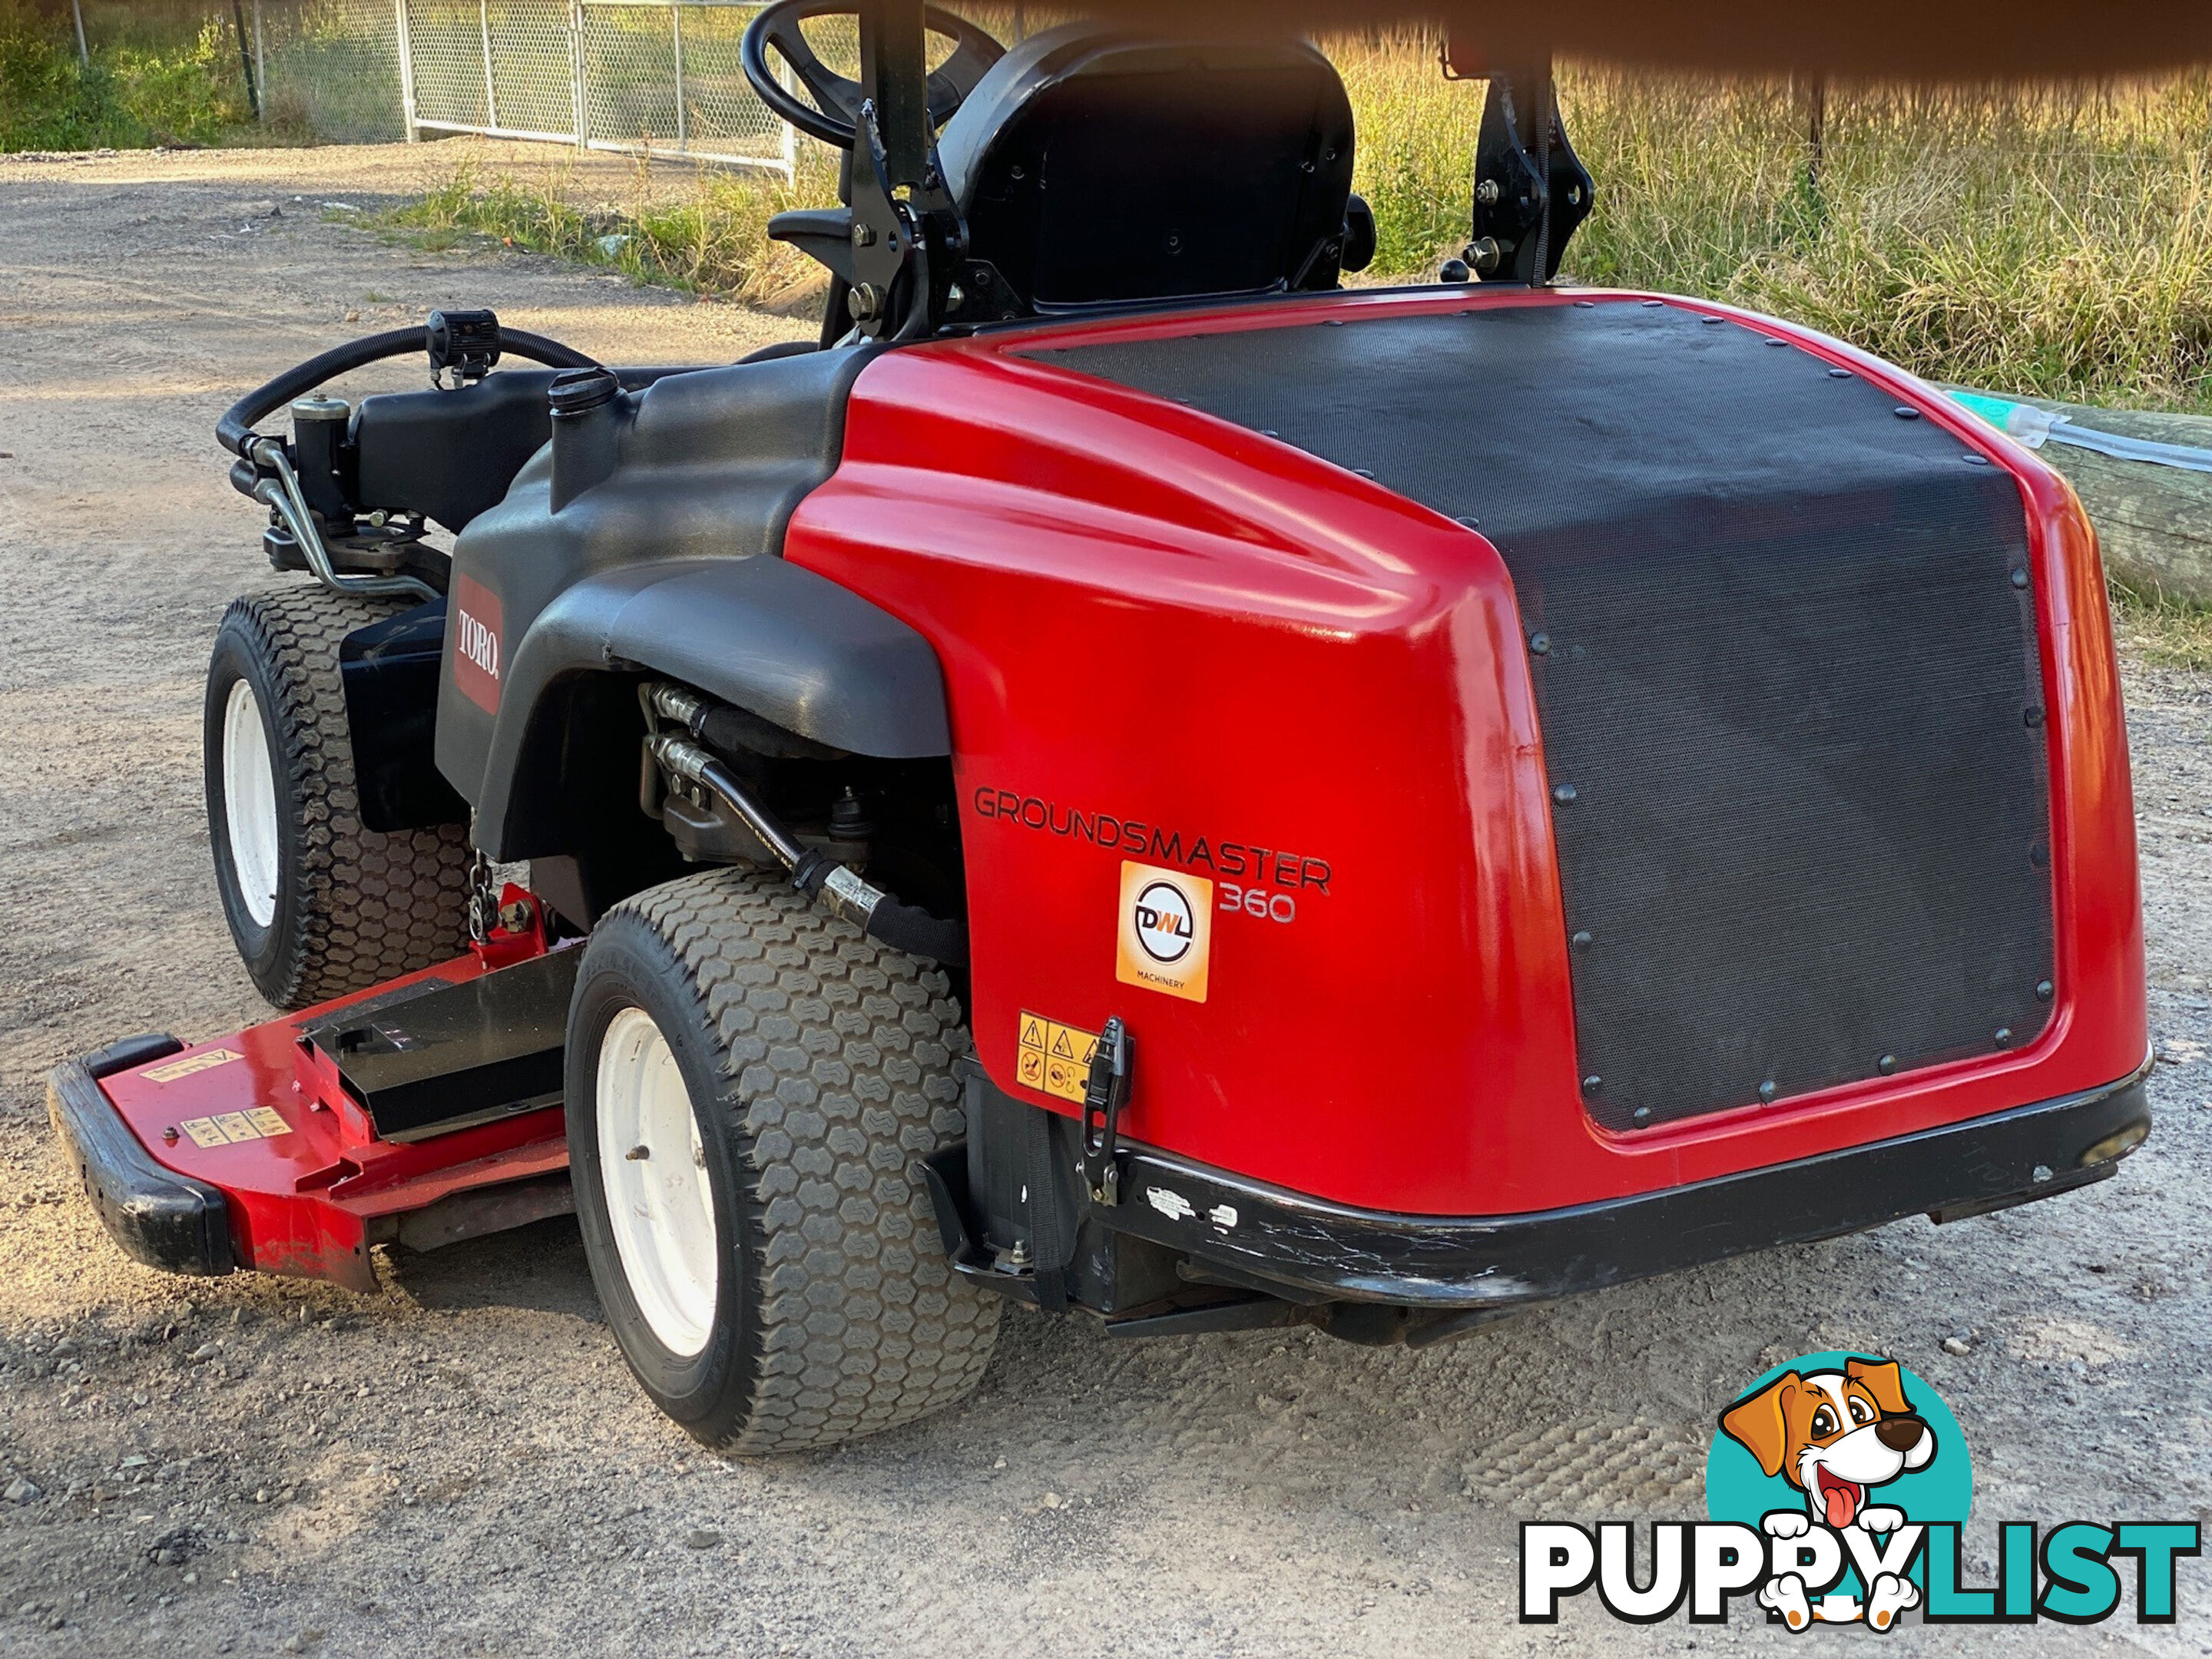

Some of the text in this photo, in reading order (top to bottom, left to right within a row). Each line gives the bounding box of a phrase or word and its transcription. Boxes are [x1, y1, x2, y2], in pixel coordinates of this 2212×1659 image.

[459, 609, 498, 677] TORO
[974, 786, 1333, 896] GROUNDSMASTER
[1136, 905, 1193, 939] DWL
[1219, 882, 1296, 924] 360
[1137, 970, 1186, 990] MACHINERY
